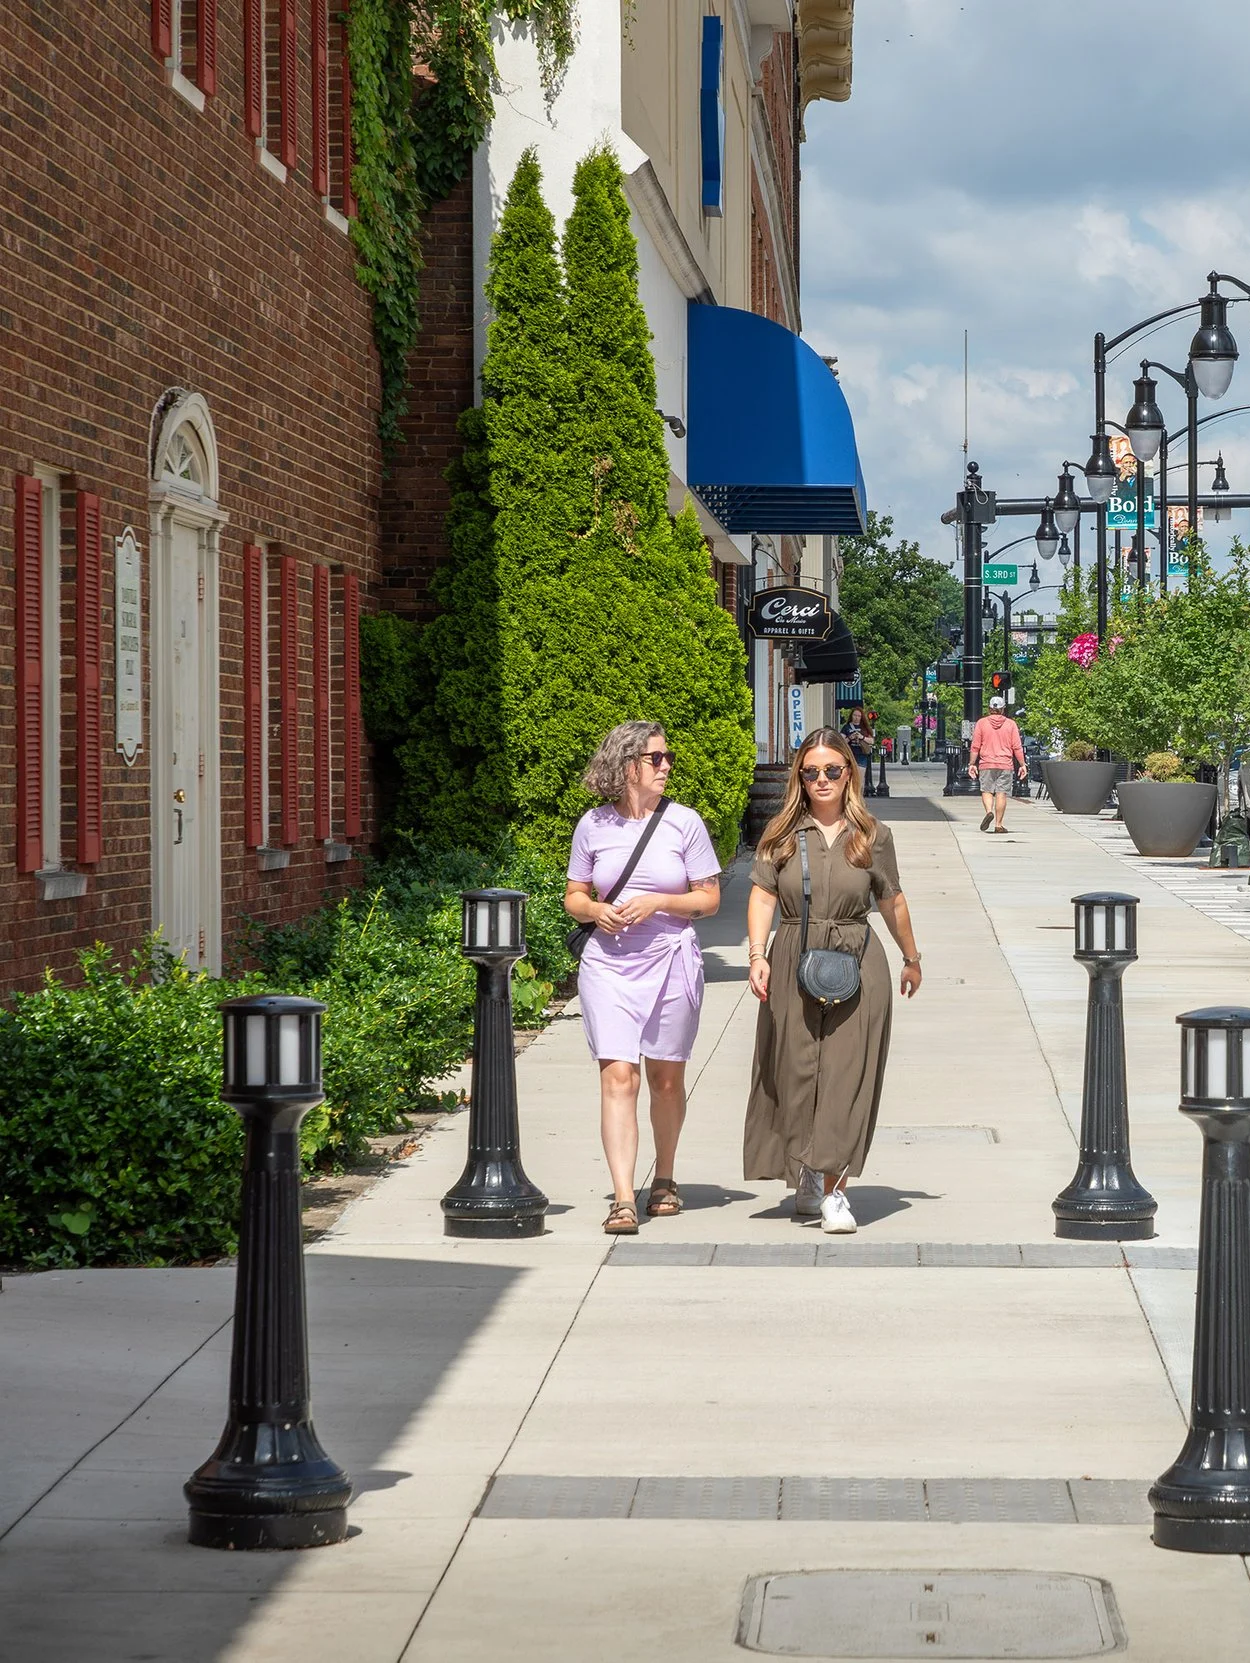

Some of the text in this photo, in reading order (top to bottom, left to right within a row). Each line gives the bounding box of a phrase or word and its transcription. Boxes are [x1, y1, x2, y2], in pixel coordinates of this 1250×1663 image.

[984, 570, 992, 579] S.
[993, 570, 1008, 579] 3RD
[761, 597, 820, 620] Cerci
[775, 616, 807, 624] On Main
[763, 627, 789, 635] APPAREL
[791, 627, 796, 635] &
[791, 688, 803, 732] OPEN
